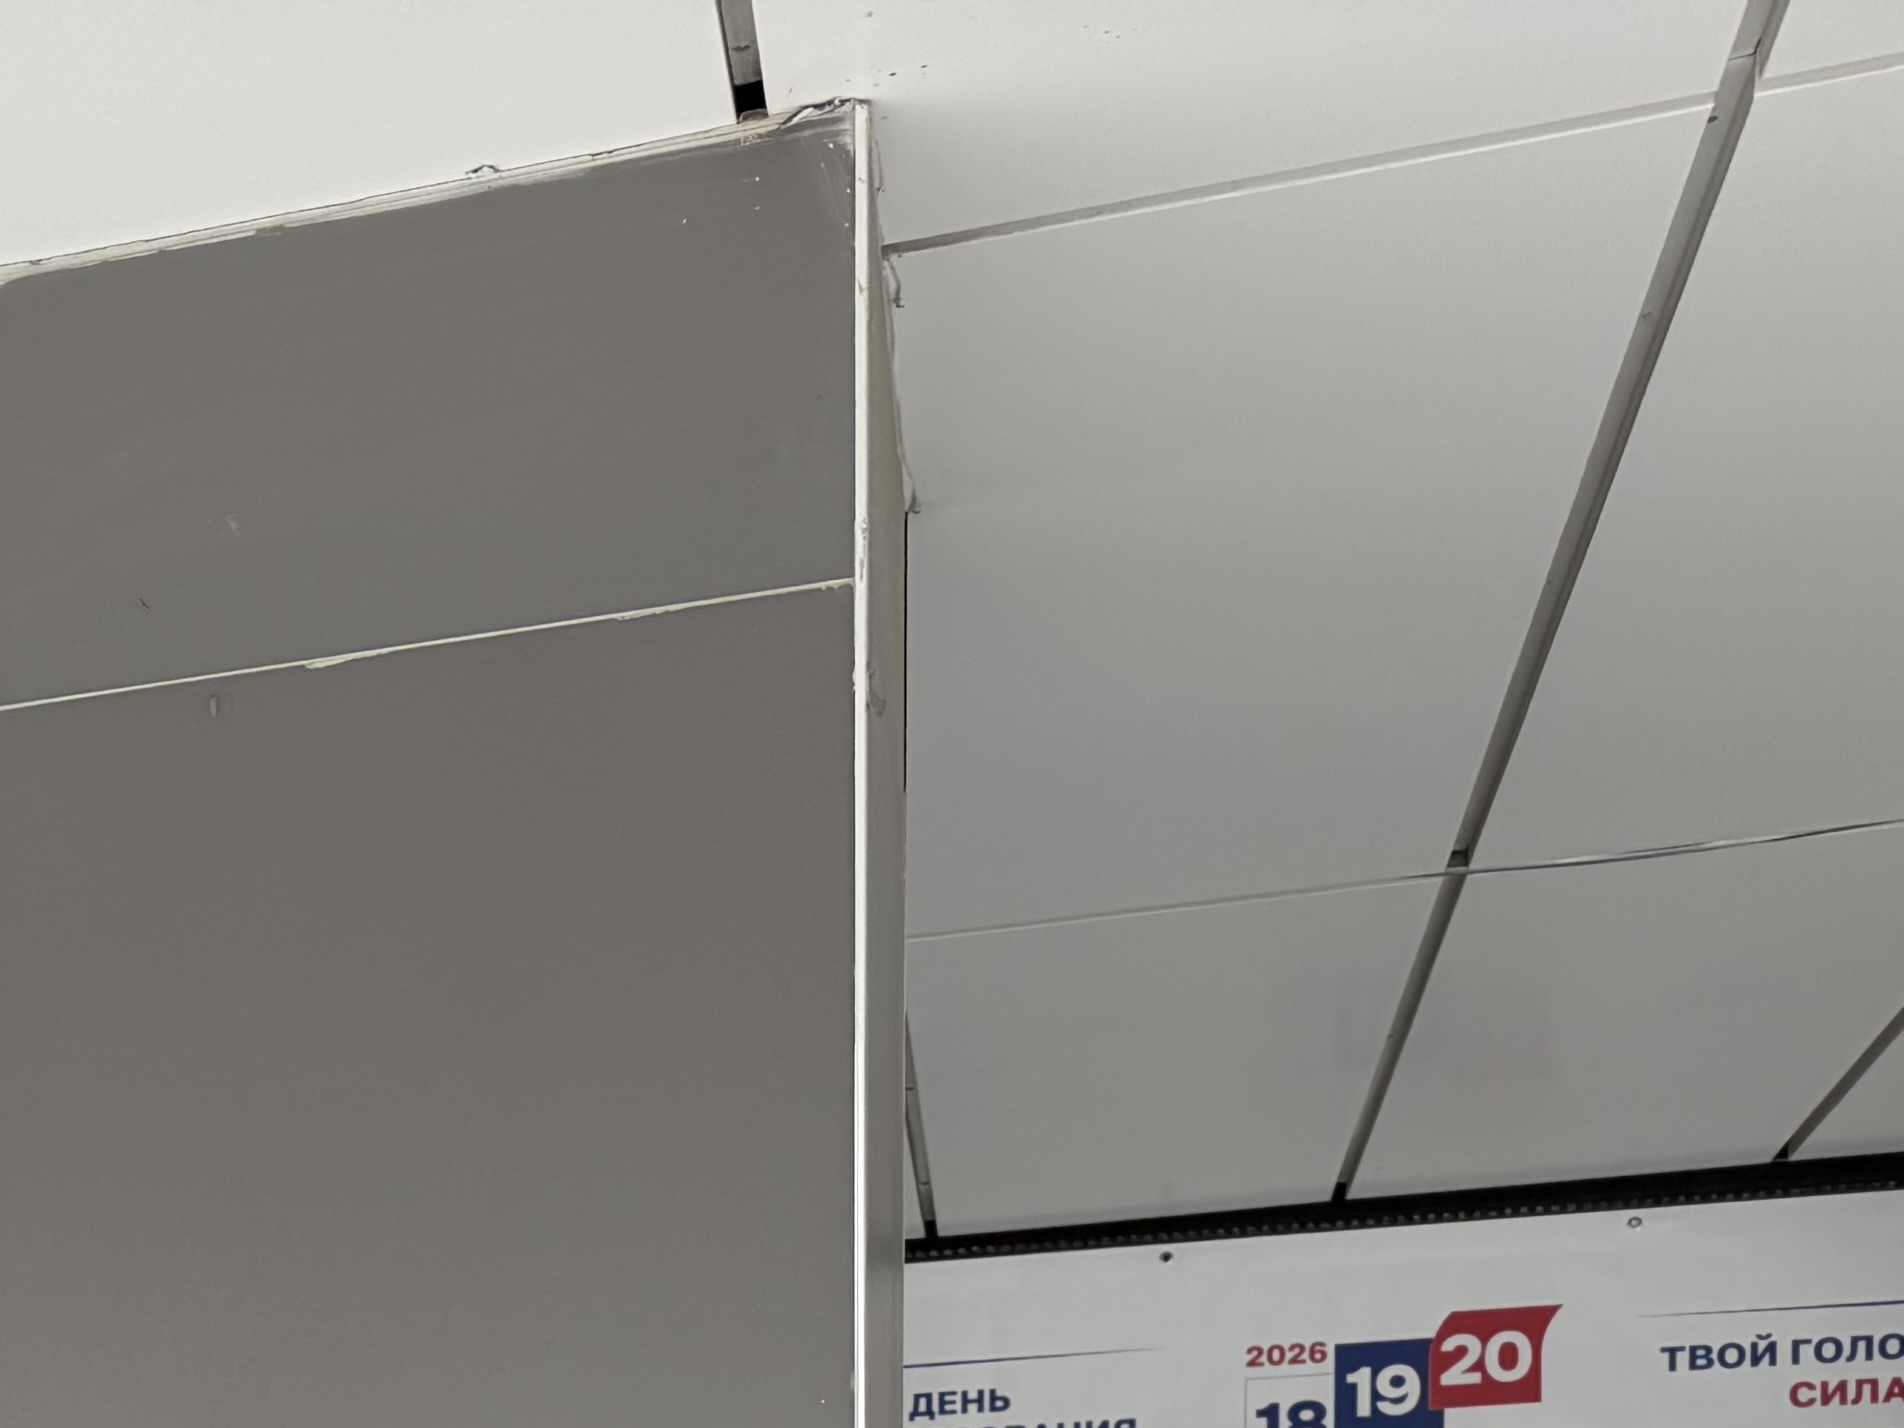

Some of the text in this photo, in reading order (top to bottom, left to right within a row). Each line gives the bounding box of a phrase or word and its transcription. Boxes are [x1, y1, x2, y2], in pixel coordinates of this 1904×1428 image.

[1245, 1341, 1328, 1368] 2026
[1438, 1329, 1533, 1386] 20
[1660, 1332, 1904, 1372] ТВОЙ ГОЛО
[908, 1388, 1011, 1421] ДЕНЬ
[1344, 1363, 1422, 1418] 19
[1788, 1376, 1904, 1408] СИЛА
